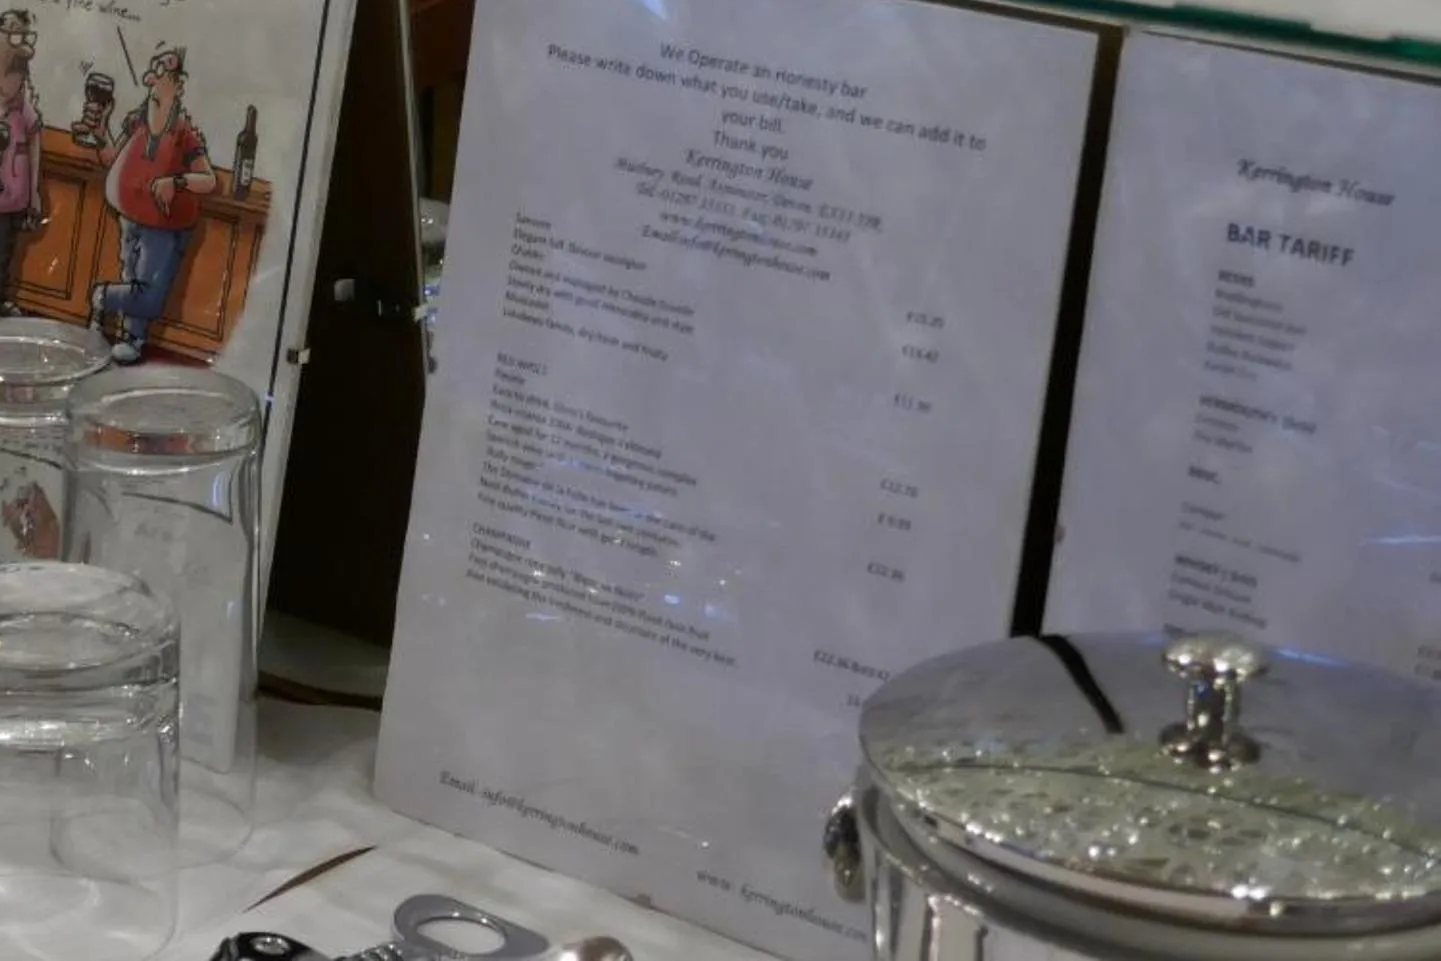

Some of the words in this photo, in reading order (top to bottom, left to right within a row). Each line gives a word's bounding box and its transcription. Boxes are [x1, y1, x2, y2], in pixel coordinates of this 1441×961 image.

[660, 42, 684, 59] We
[688, 49, 749, 73] Operate
[840, 80, 868, 99] bar
[548, 43, 591, 67] Please
[595, 58, 630, 76] write
[635, 65, 676, 85] down
[681, 76, 718, 93] what
[721, 84, 747, 100] you
[826, 106, 855, 124] and
[860, 113, 883, 128] we
[887, 120, 914, 135] can
[918, 125, 950, 143] add
[953, 129, 965, 147] it
[969, 134, 987, 151] to
[722, 111, 756, 128] your
[714, 129, 756, 152] Thank
[761, 144, 789, 161] you
[1227, 222, 1272, 250] BAR
[1278, 232, 1356, 267] TARIFF
